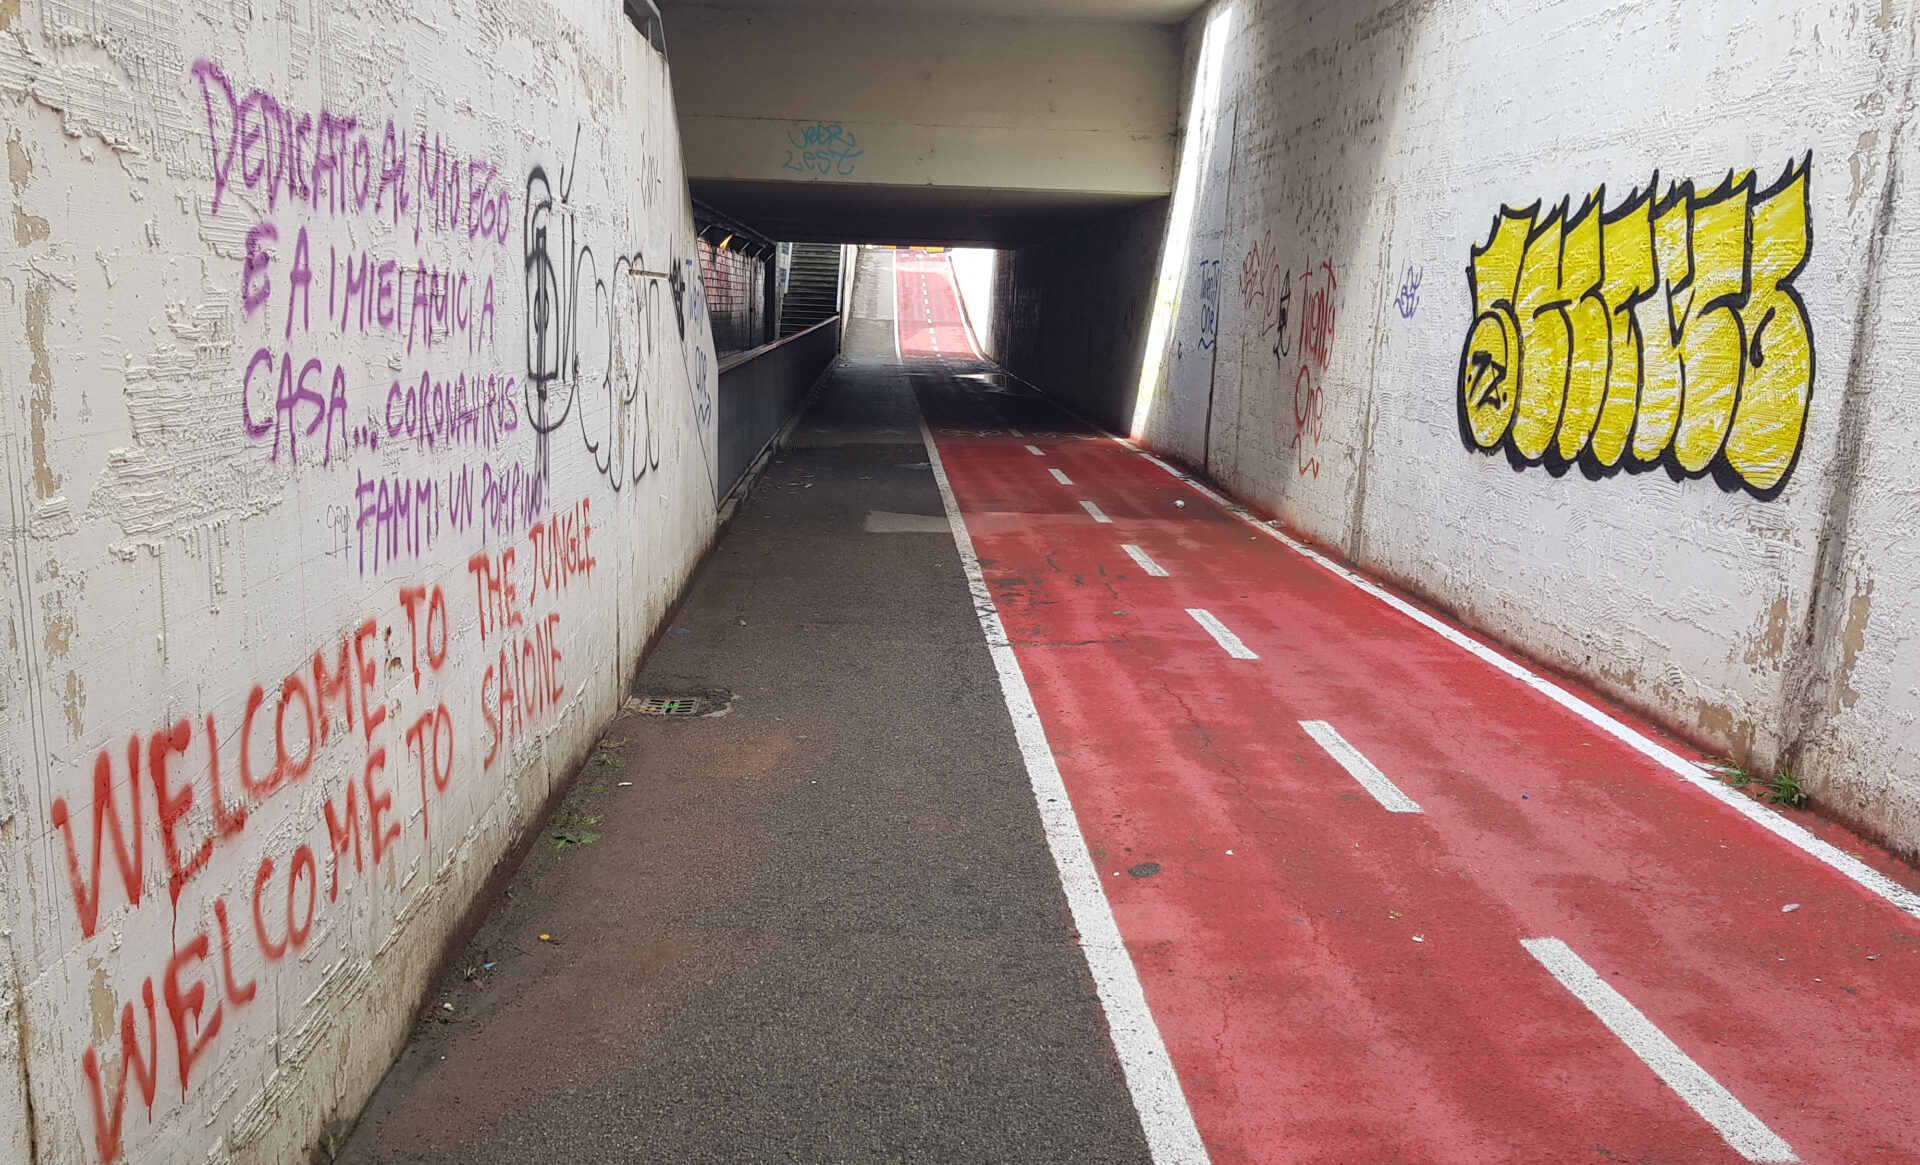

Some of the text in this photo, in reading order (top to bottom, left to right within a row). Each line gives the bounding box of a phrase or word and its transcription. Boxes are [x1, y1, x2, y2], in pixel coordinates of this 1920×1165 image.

[191, 58, 371, 216] DEDICATO
[375, 117, 409, 228] AL
[414, 131, 460, 247] MIO
[468, 155, 510, 245] EGO
[243, 221, 278, 316] E
[286, 225, 312, 341] A
[329, 245, 336, 321] I
[478, 273, 496, 354] A
[355, 467, 440, 577] FAMMI
[449, 462, 474, 536] UN
[53, 497, 597, 940] WELCOME TO THE JUNGLE
[82, 747, 401, 1164] WELCOME
[407, 702, 454, 840] TO
